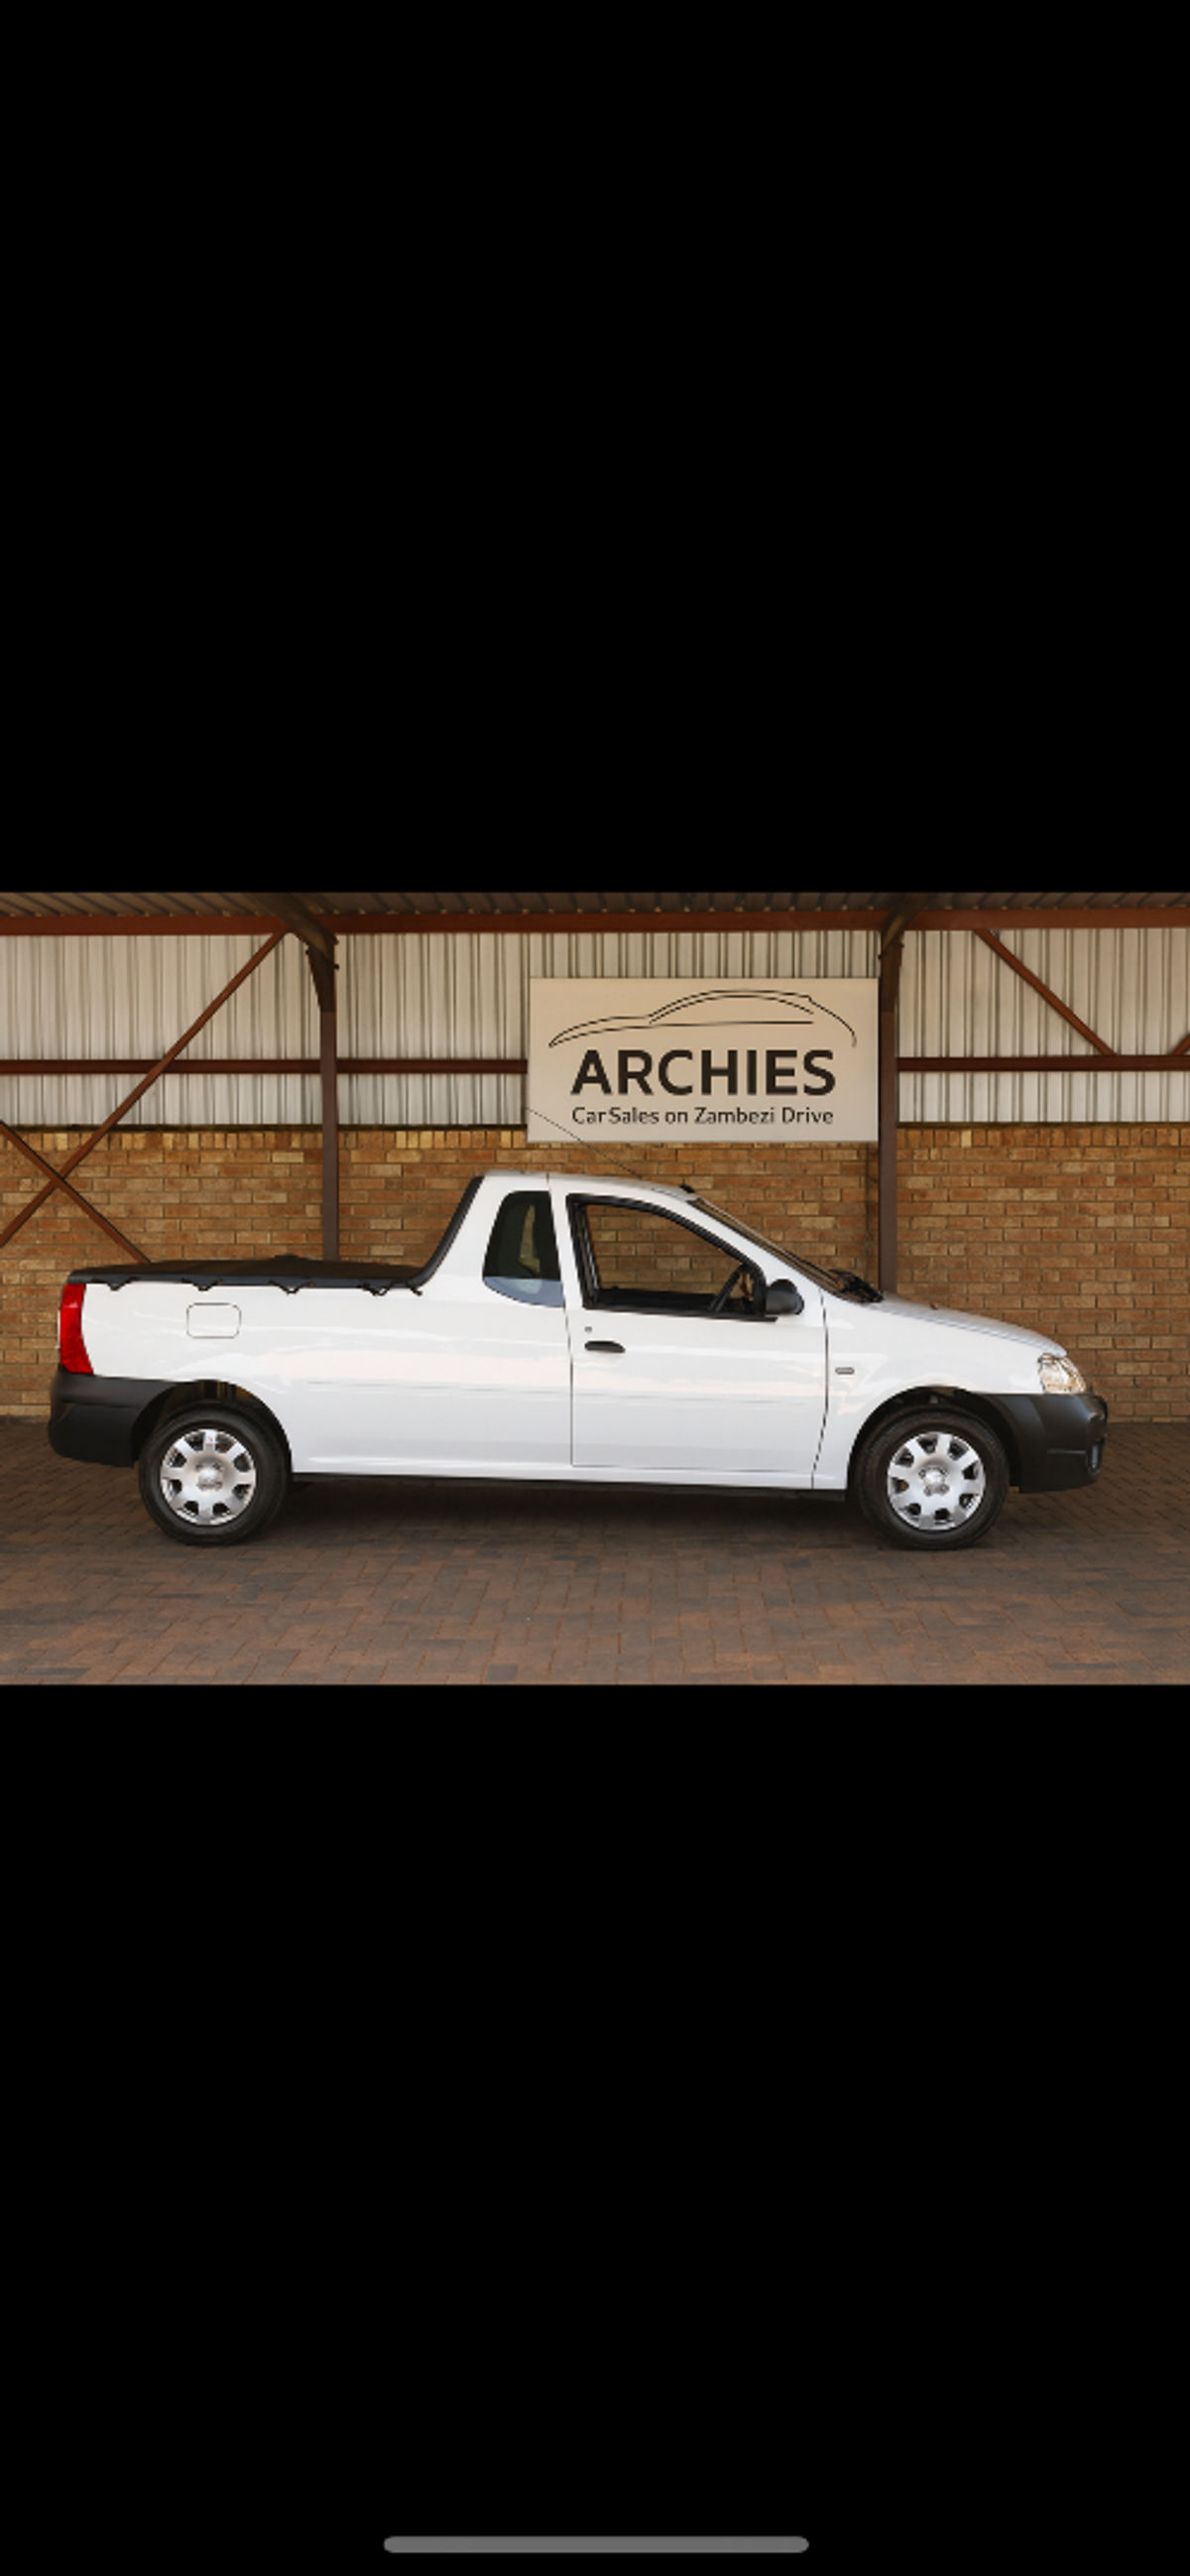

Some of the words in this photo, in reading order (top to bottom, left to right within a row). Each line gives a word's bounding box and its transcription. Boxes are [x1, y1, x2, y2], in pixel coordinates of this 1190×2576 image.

[571, 1049, 836, 1095] ARCHIES
[571, 1107, 607, 1125] Car
[608, 1106, 659, 1125] Sales
[664, 1111, 689, 1125] on
[694, 1106, 775, 1125] Zambezi
[781, 1106, 834, 1125] Drive
